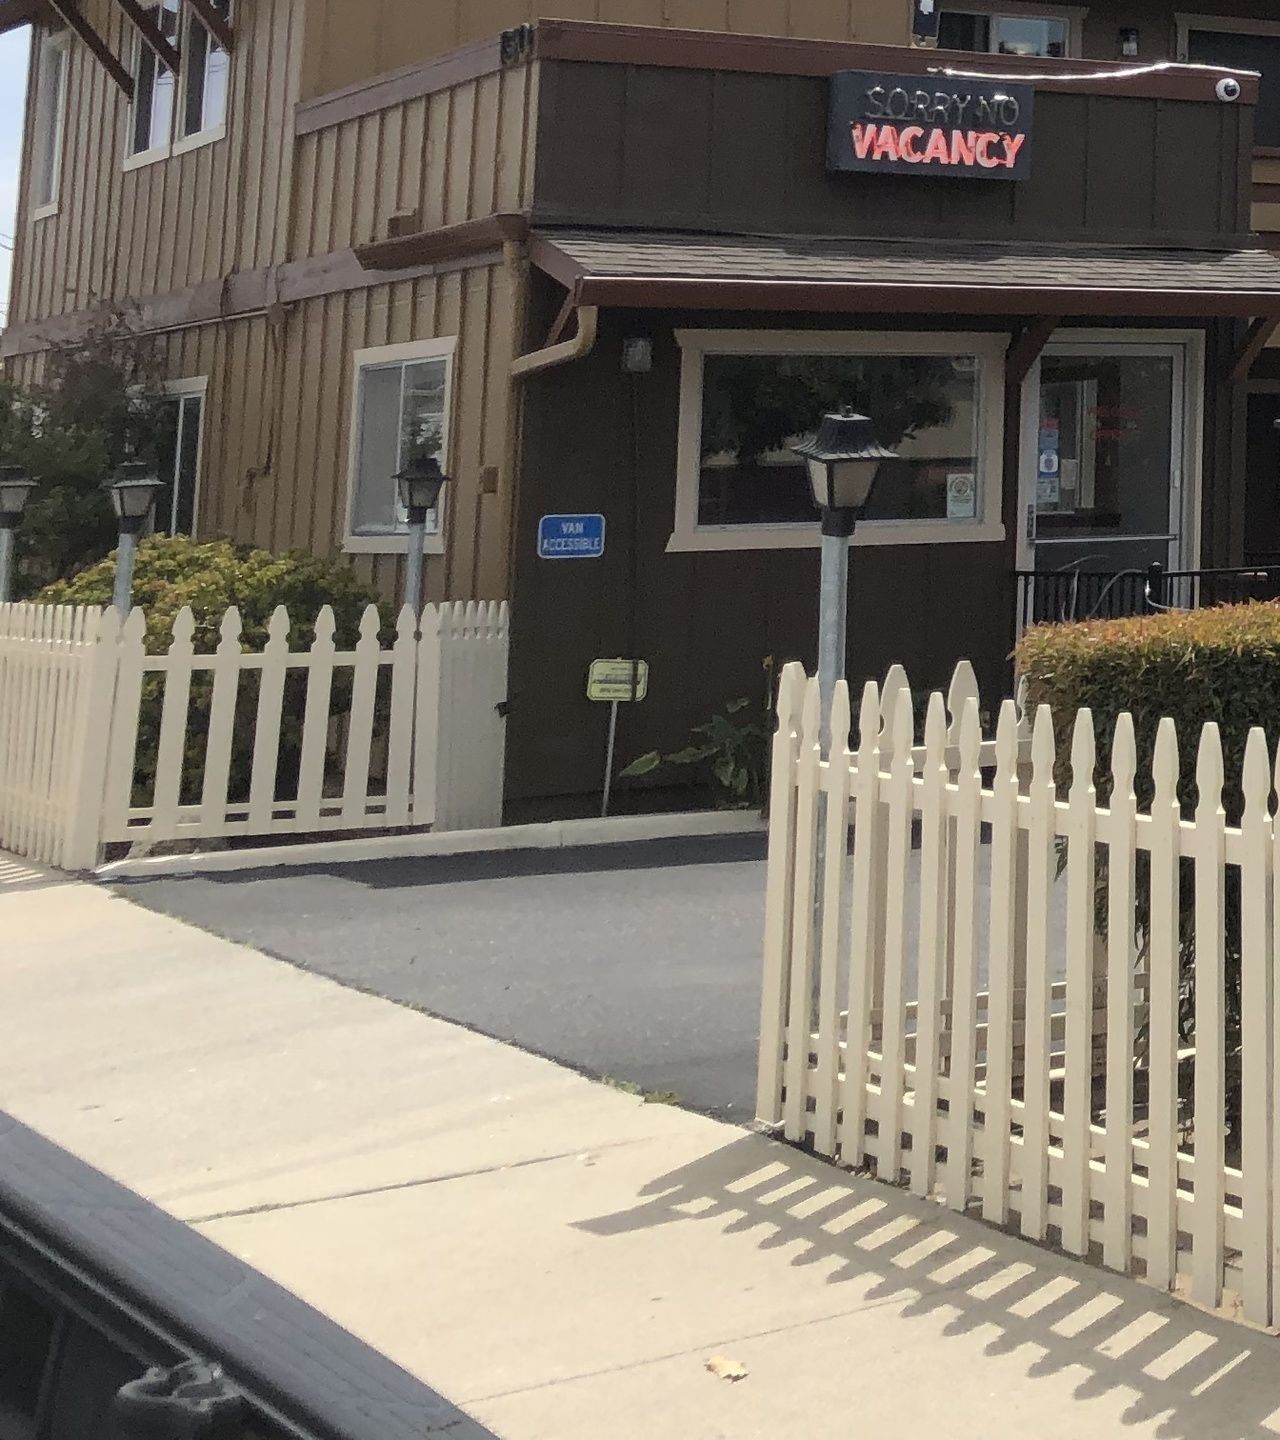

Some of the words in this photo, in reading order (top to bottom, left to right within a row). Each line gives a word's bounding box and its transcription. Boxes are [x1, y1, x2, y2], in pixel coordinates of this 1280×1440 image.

[864, 84, 972, 123] SORRY
[978, 91, 1020, 126] NO
[849, 120, 1026, 169] VACANCY
[560, 521, 585, 535] VAN
[542, 536, 601, 552] ACCESSIBLE
